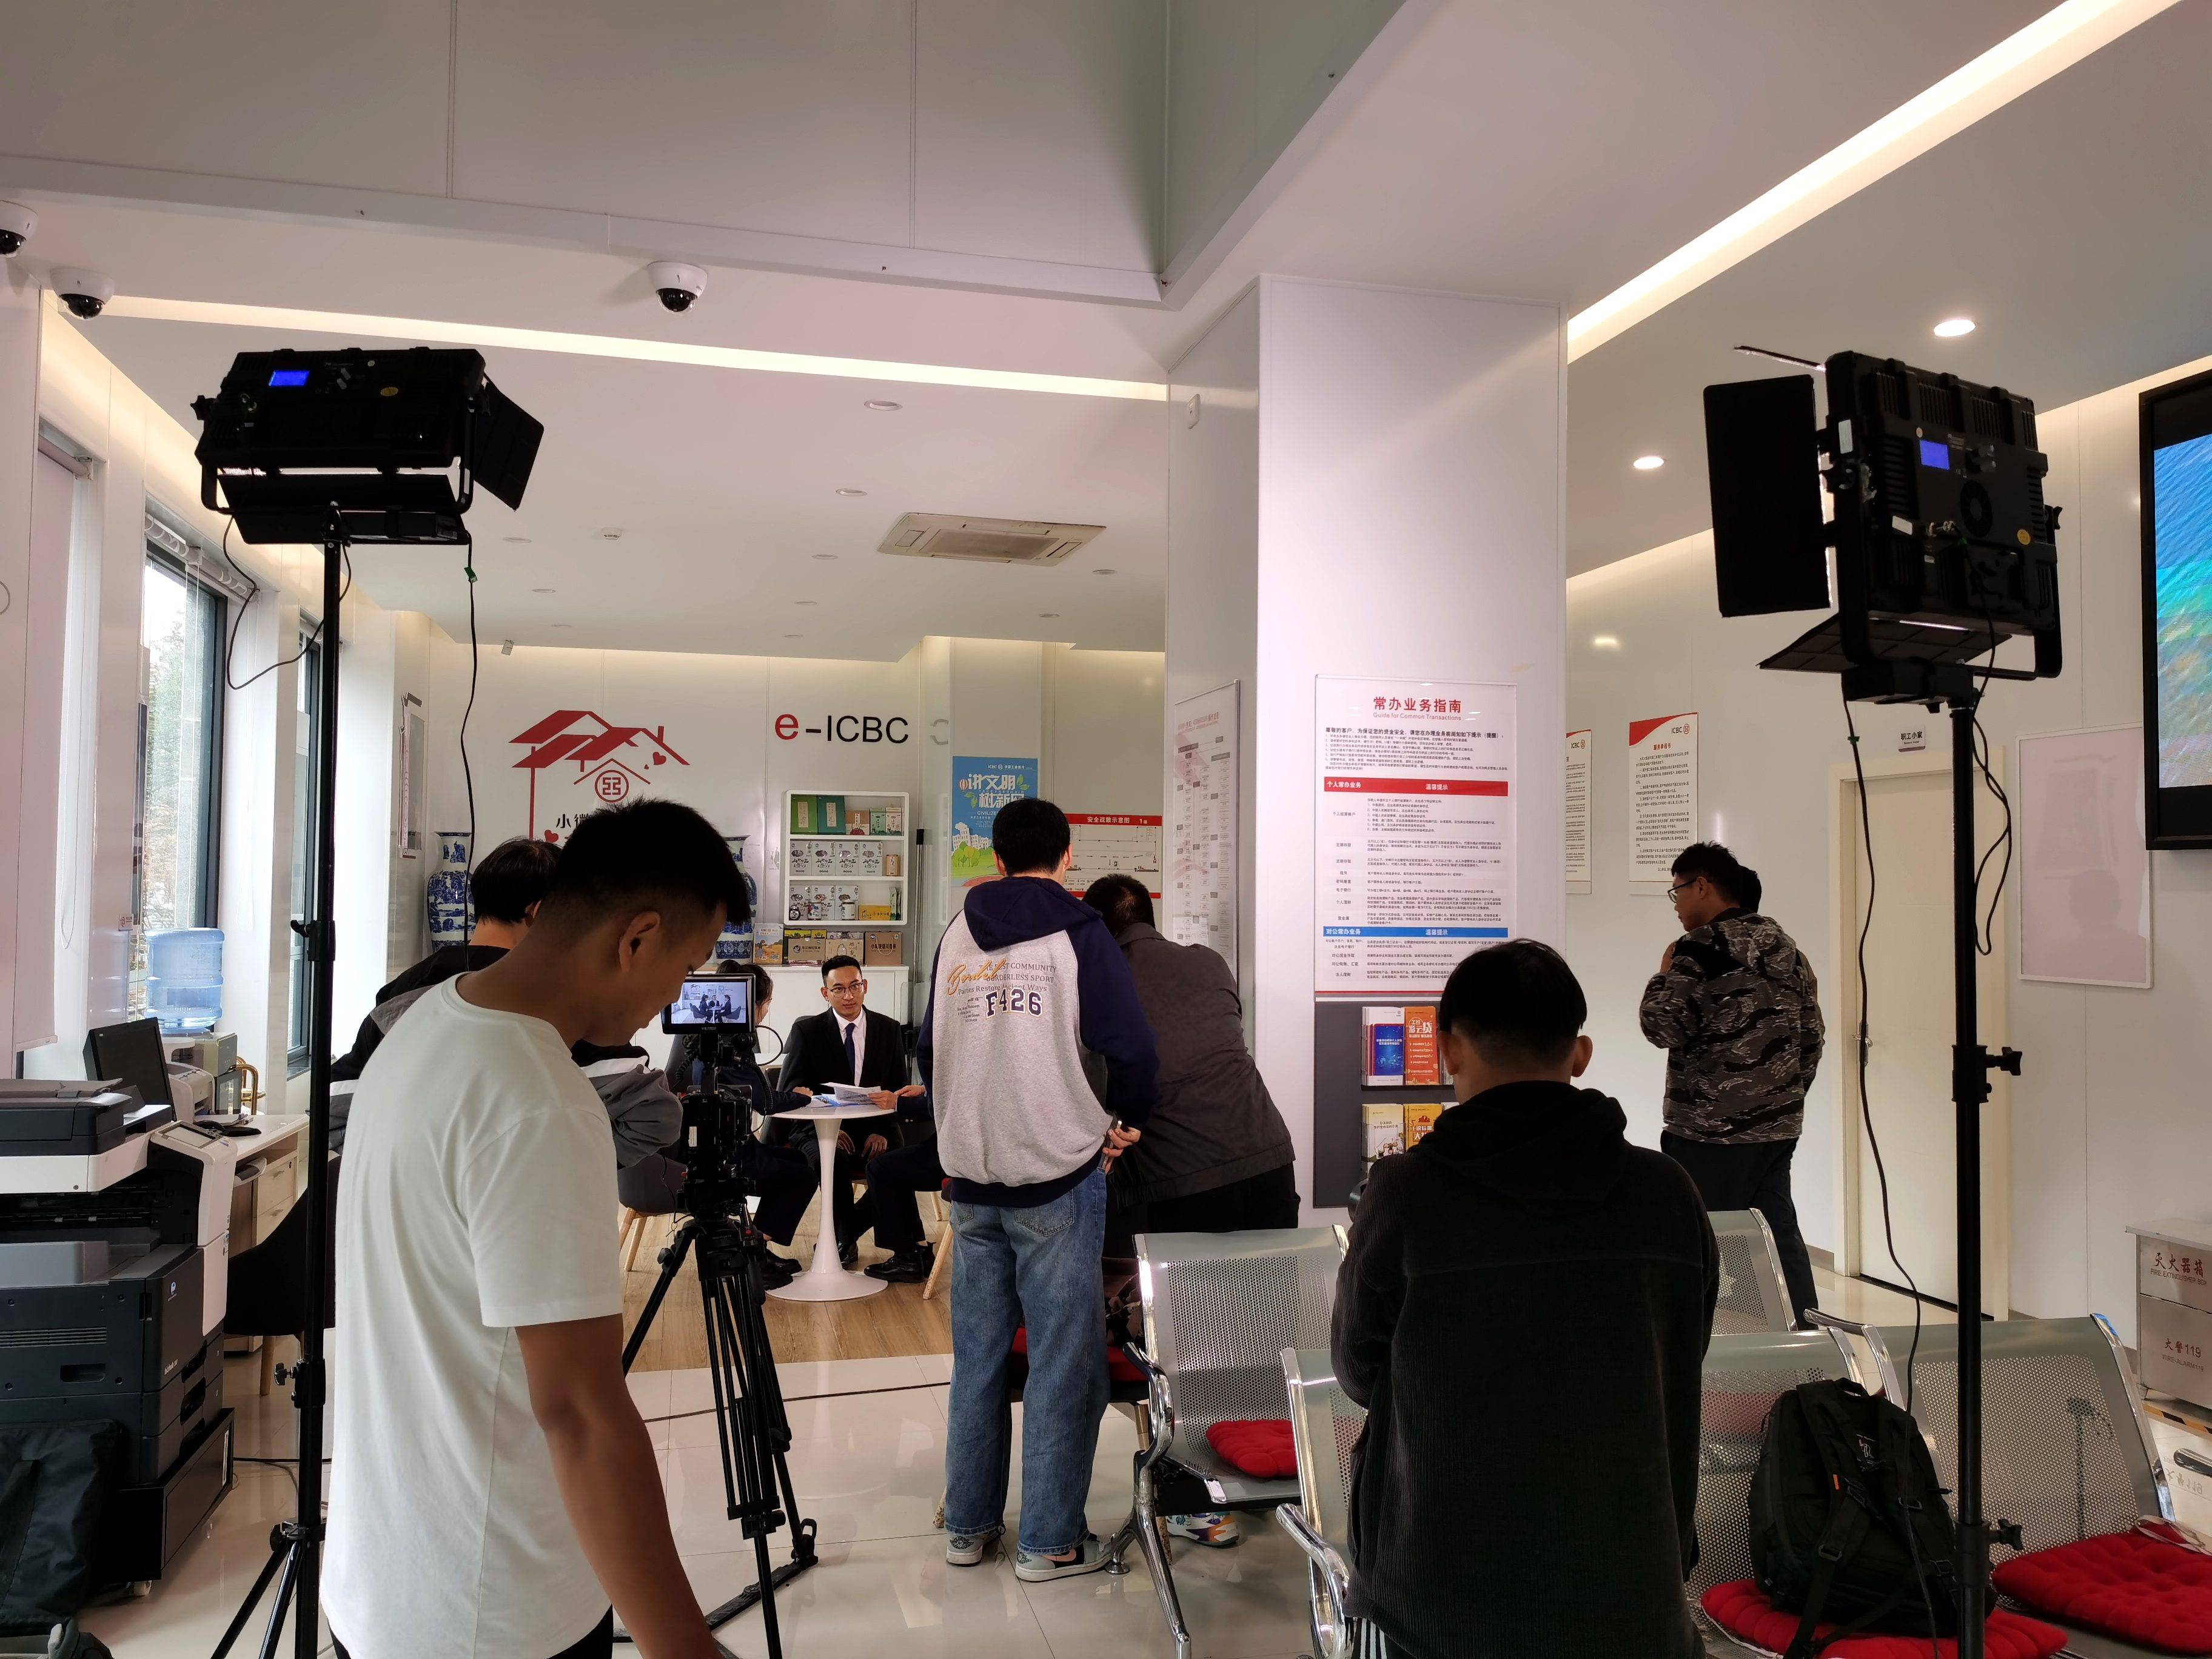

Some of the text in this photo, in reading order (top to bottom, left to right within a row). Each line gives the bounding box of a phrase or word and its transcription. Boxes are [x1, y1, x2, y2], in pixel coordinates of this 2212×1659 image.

[1373, 697, 1461, 713] 常办业务指南
[775, 714, 908, 743] e-ICBC
[1901, 731, 1922, 740] 职工小家
[968, 774, 1016, 790] 讲文明
[1010, 963, 1056, 973] COMMUNITY
[1031, 974, 1054, 983] SPORT
[985, 988, 1043, 1019] F426
